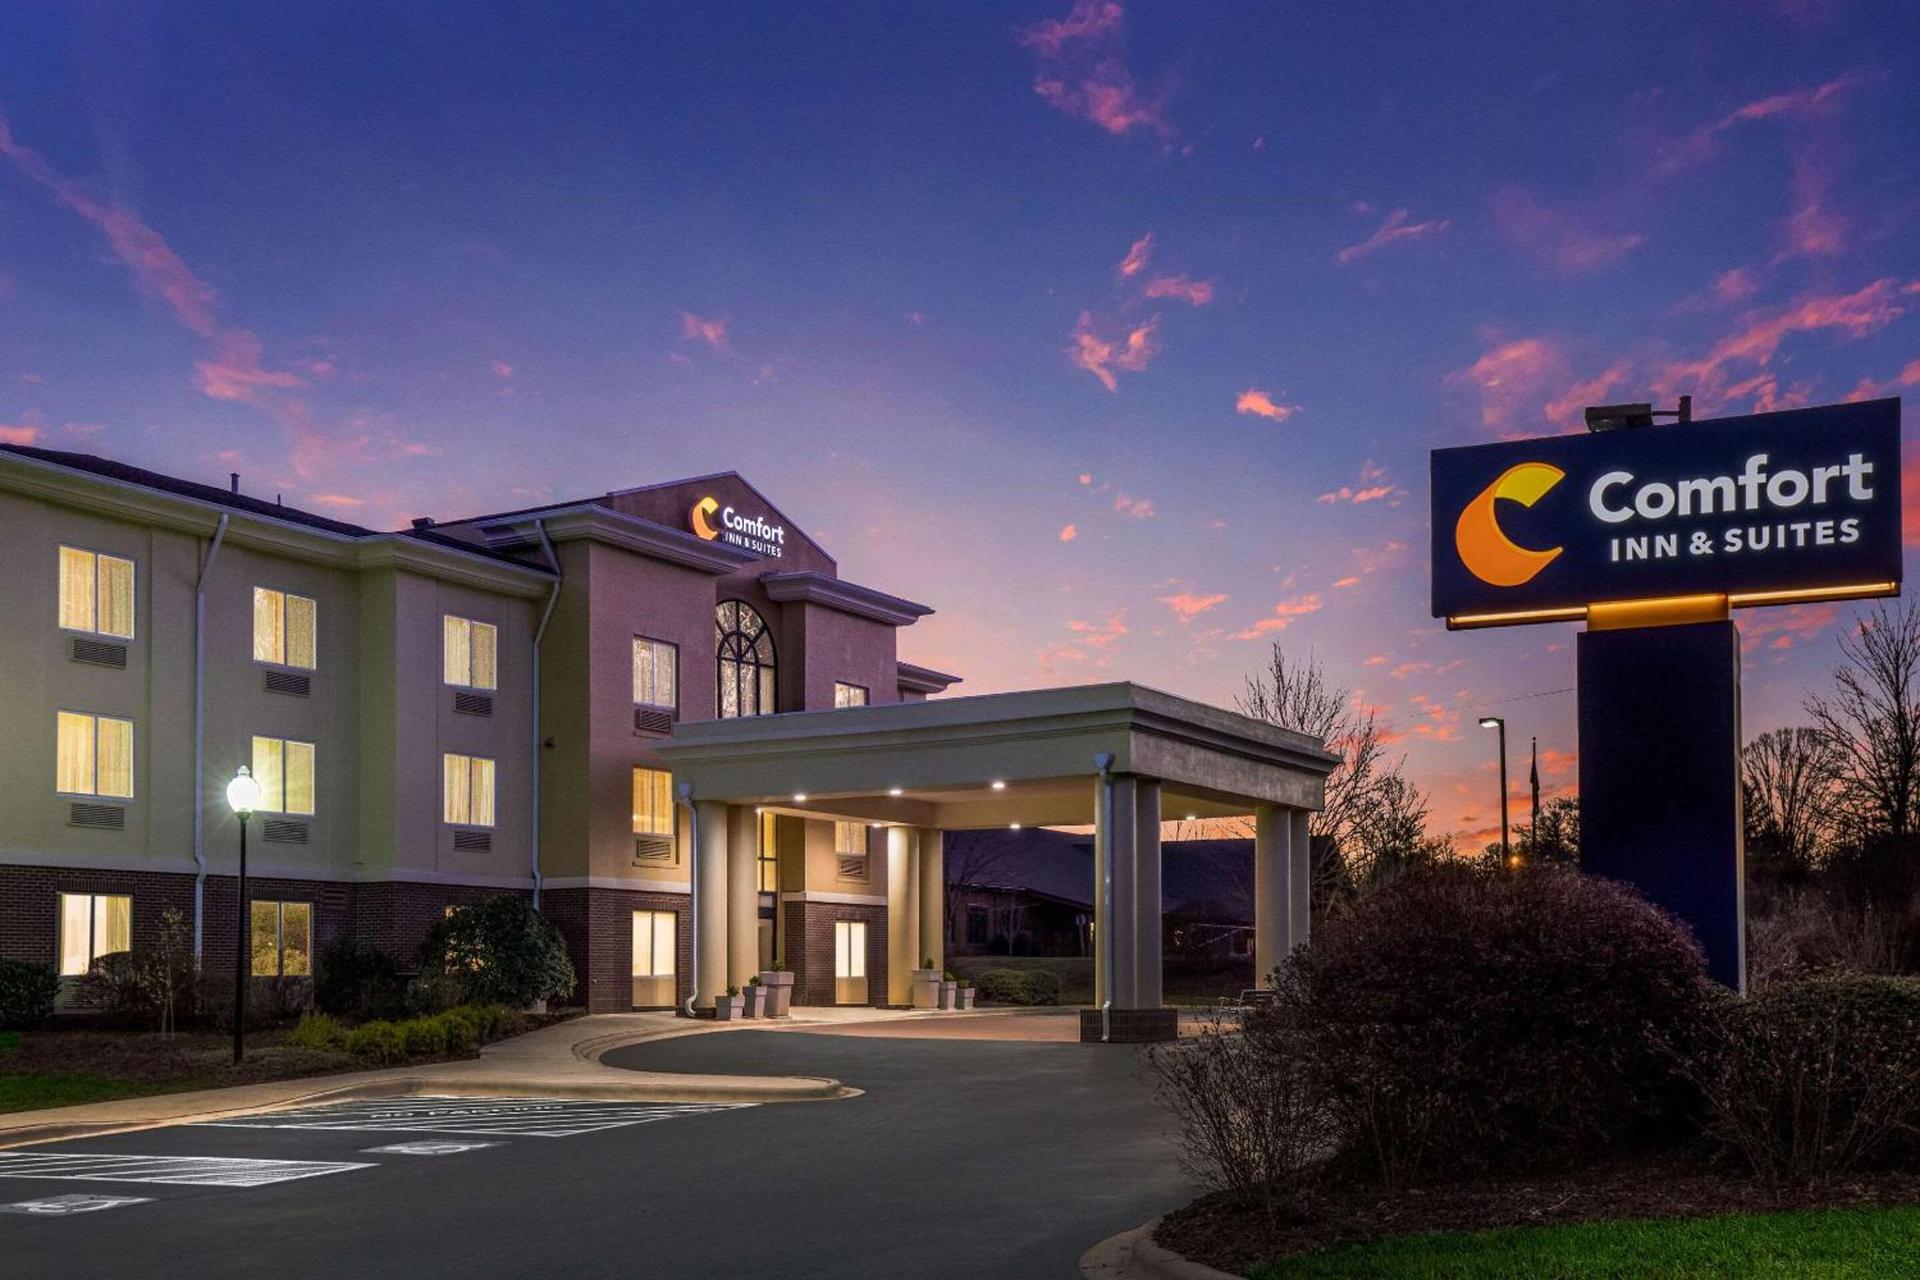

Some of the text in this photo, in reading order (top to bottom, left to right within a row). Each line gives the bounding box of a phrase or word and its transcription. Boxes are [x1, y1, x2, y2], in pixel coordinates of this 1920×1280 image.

[1589, 454, 1874, 523] Comfort
[723, 507, 784, 544] Comfort
[725, 532, 782, 557] INN & SUITES
[1611, 518, 1860, 562] INN & SUITES
